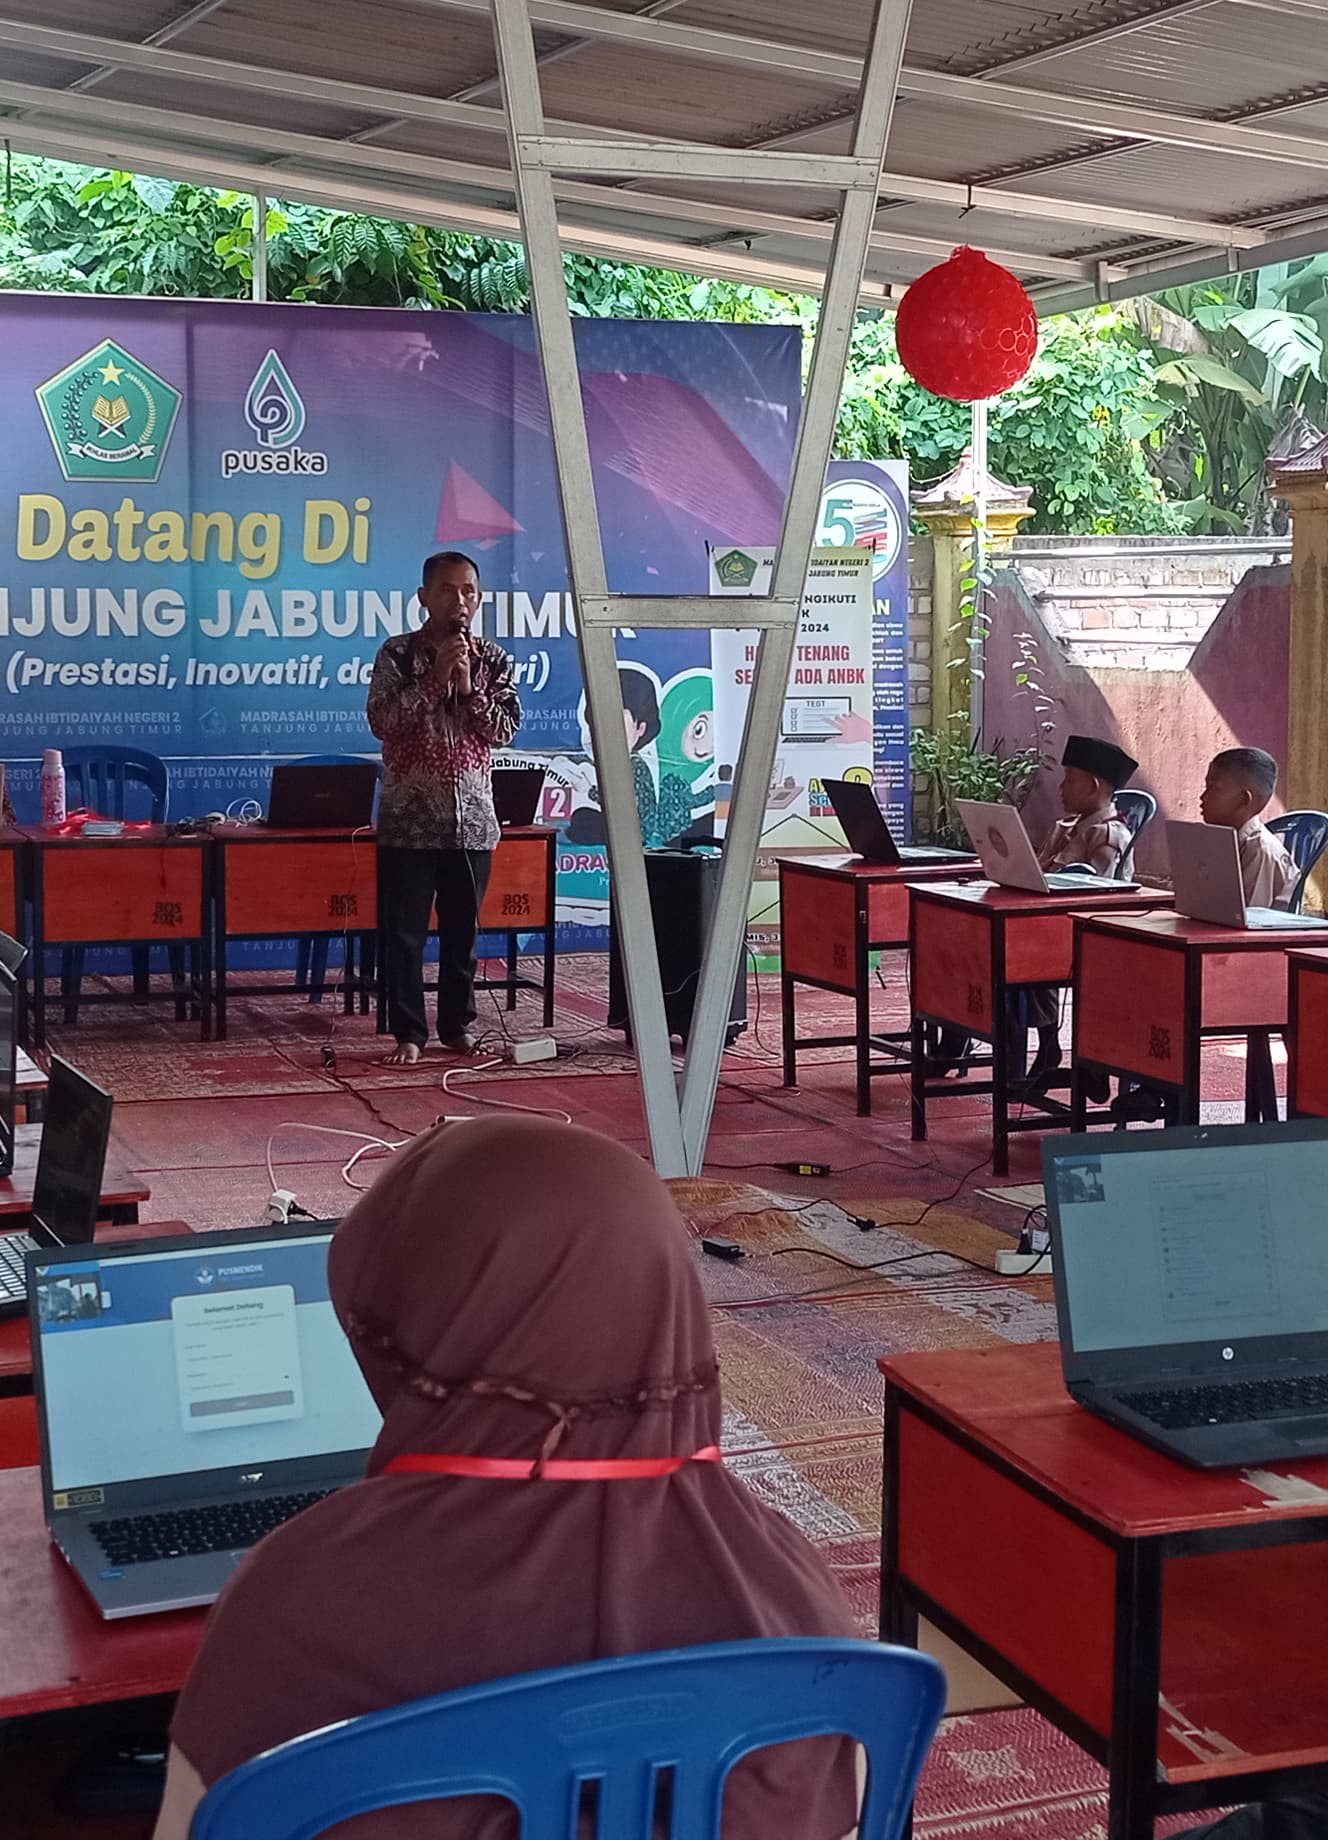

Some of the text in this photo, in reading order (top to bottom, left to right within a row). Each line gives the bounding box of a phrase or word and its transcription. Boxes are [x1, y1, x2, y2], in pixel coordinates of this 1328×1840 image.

[224, 449, 326, 477] pusaka
[16, 494, 282, 579] Datang
[303, 497, 371, 564] Di
[804, 594, 857, 604] NGIKUTI
[800, 623, 830, 633] 2024
[796, 645, 850, 662] TENANG
[6, 650, 177, 693] (Prestasi,
[186, 654, 329, 690] Inovatif,
[735, 668, 865, 685] SE ADA ANBK
[46, 712, 122, 723] IBTIDAIYAH
[124, 711, 170, 723] NEGERI
[172, 712, 180, 722] 2
[240, 711, 367, 722] MADRASAH IBTIDAIY
[520, 709, 572, 720] DRASAH
[55, 725, 124, 735] JABUNG
[130, 725, 183, 734] TIMUR
[240, 723, 371, 733] TANJUNG JABU
[5, 768, 33, 780] GERI
[183, 767, 259, 778] IBTIDAIYAH
[537, 762, 570, 789] Timur
[191, 779, 259, 790] JABUNG
[549, 787, 566, 818] 2
[556, 854, 609, 873] DRA
[504, 893, 529, 905] BOS
[501, 904, 530, 915] 2024
[243, 941, 296, 950] TANJU
